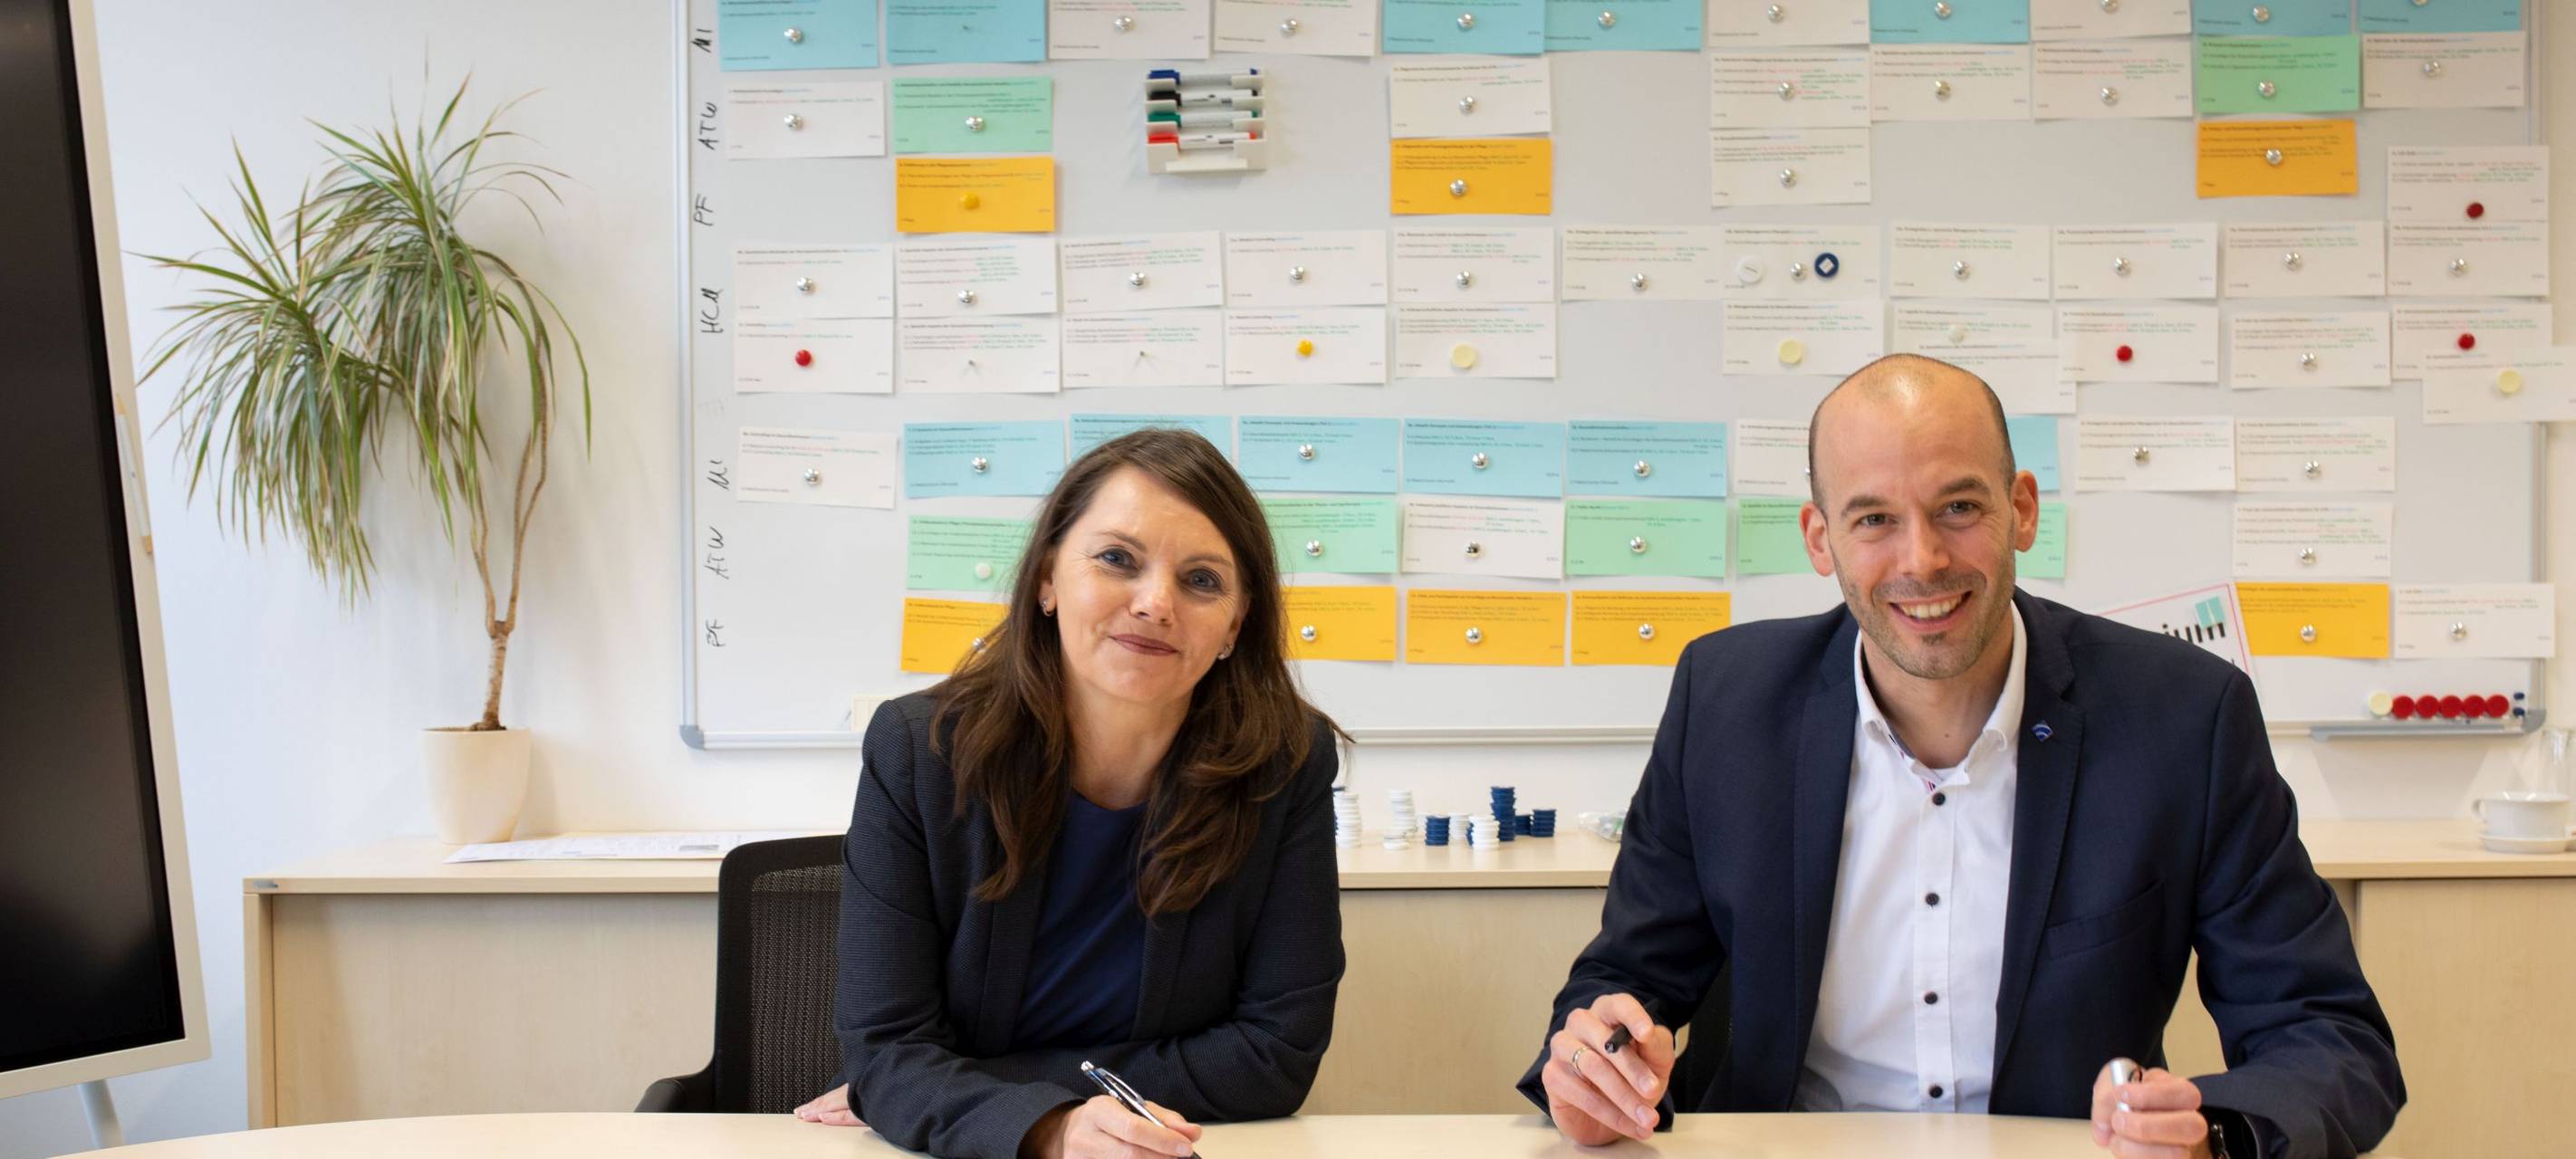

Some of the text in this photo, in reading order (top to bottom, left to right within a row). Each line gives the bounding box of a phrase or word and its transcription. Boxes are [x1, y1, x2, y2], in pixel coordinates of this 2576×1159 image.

[697, 101, 719, 151] ATW
[693, 193, 714, 227] PF
[704, 526, 729, 580] ATW
